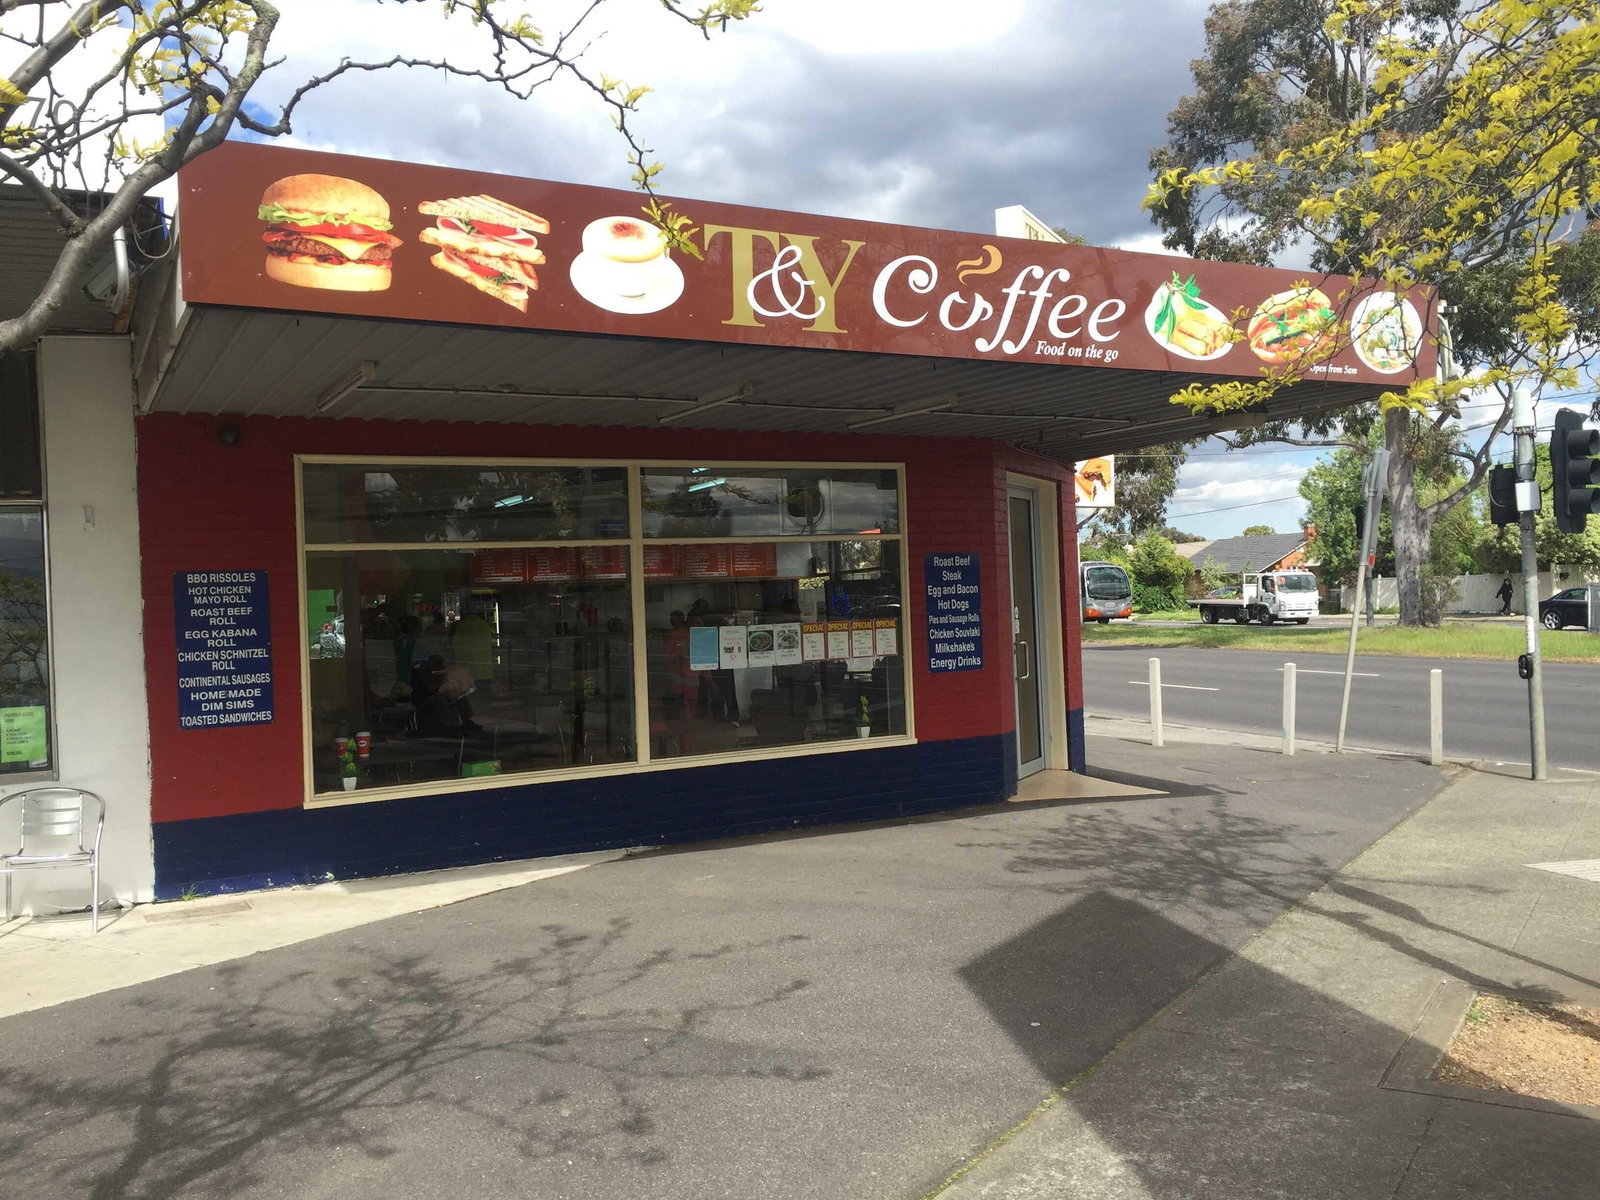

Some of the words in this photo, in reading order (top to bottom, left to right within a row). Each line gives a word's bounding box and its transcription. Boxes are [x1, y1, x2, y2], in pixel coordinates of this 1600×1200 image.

[872, 254, 1126, 355] Coffee
[1035, 340, 1065, 358] Food
[1067, 346, 1082, 358] on
[1085, 344, 1103, 360] the
[1105, 347, 1119, 363] go
[1328, 364, 1342, 374] from
[934, 557, 954, 566] Roast
[955, 556, 970, 566] Beef
[187, 574, 208, 584] BBQ
[209, 572, 256, 582] RISSOLES
[942, 571, 962, 581] Steak
[188, 587, 208, 595] HOT
[209, 586, 251, 595] CHICKEN
[928, 585, 941, 598] Egg
[943, 585, 956, 595] and
[957, 584, 978, 594] Bacon
[194, 596, 220, 604] MAYO
[223, 595, 247, 603] ROLL
[938, 600, 950, 610] Hot
[951, 599, 969, 611] Dogs
[191, 608, 225, 616] ROAST
[227, 607, 253, 615] BEEF
[209, 617, 236, 625] ROLL
[876, 620, 896, 628] SPECIAL
[929, 615, 939, 624] Pies
[940, 615, 948, 623] and
[949, 614, 967, 624] Sausage
[968, 613, 979, 622] Rolls
[802, 624, 824, 632] SPECIAL
[828, 622, 848, 631] SPECIAL
[852, 621, 873, 629] SPECIAL
[185, 630, 209, 639] EGG
[212, 628, 257, 638] KABANA
[930, 628, 954, 639] Chicken
[955, 627, 980, 637] Souvlaki
[207, 639, 236, 647] ROLL
[178, 651, 218, 662] CHICKEN
[220, 649, 268, 660] SCHNITZEL
[212, 661, 235, 670] ROLL
[931, 658, 956, 670] Energy
[958, 655, 981, 666] Drinks
[179, 675, 230, 688] CONTINENTAL
[231, 673, 270, 685] SAUSAGES
[191, 691, 227, 701] HOME
[228, 688, 261, 698] MADE
[202, 702, 223, 712] DIM
[226, 700, 254, 709] SIMS
[181, 715, 218, 727] TOASTED
[219, 711, 272, 724] SANDWICHES
